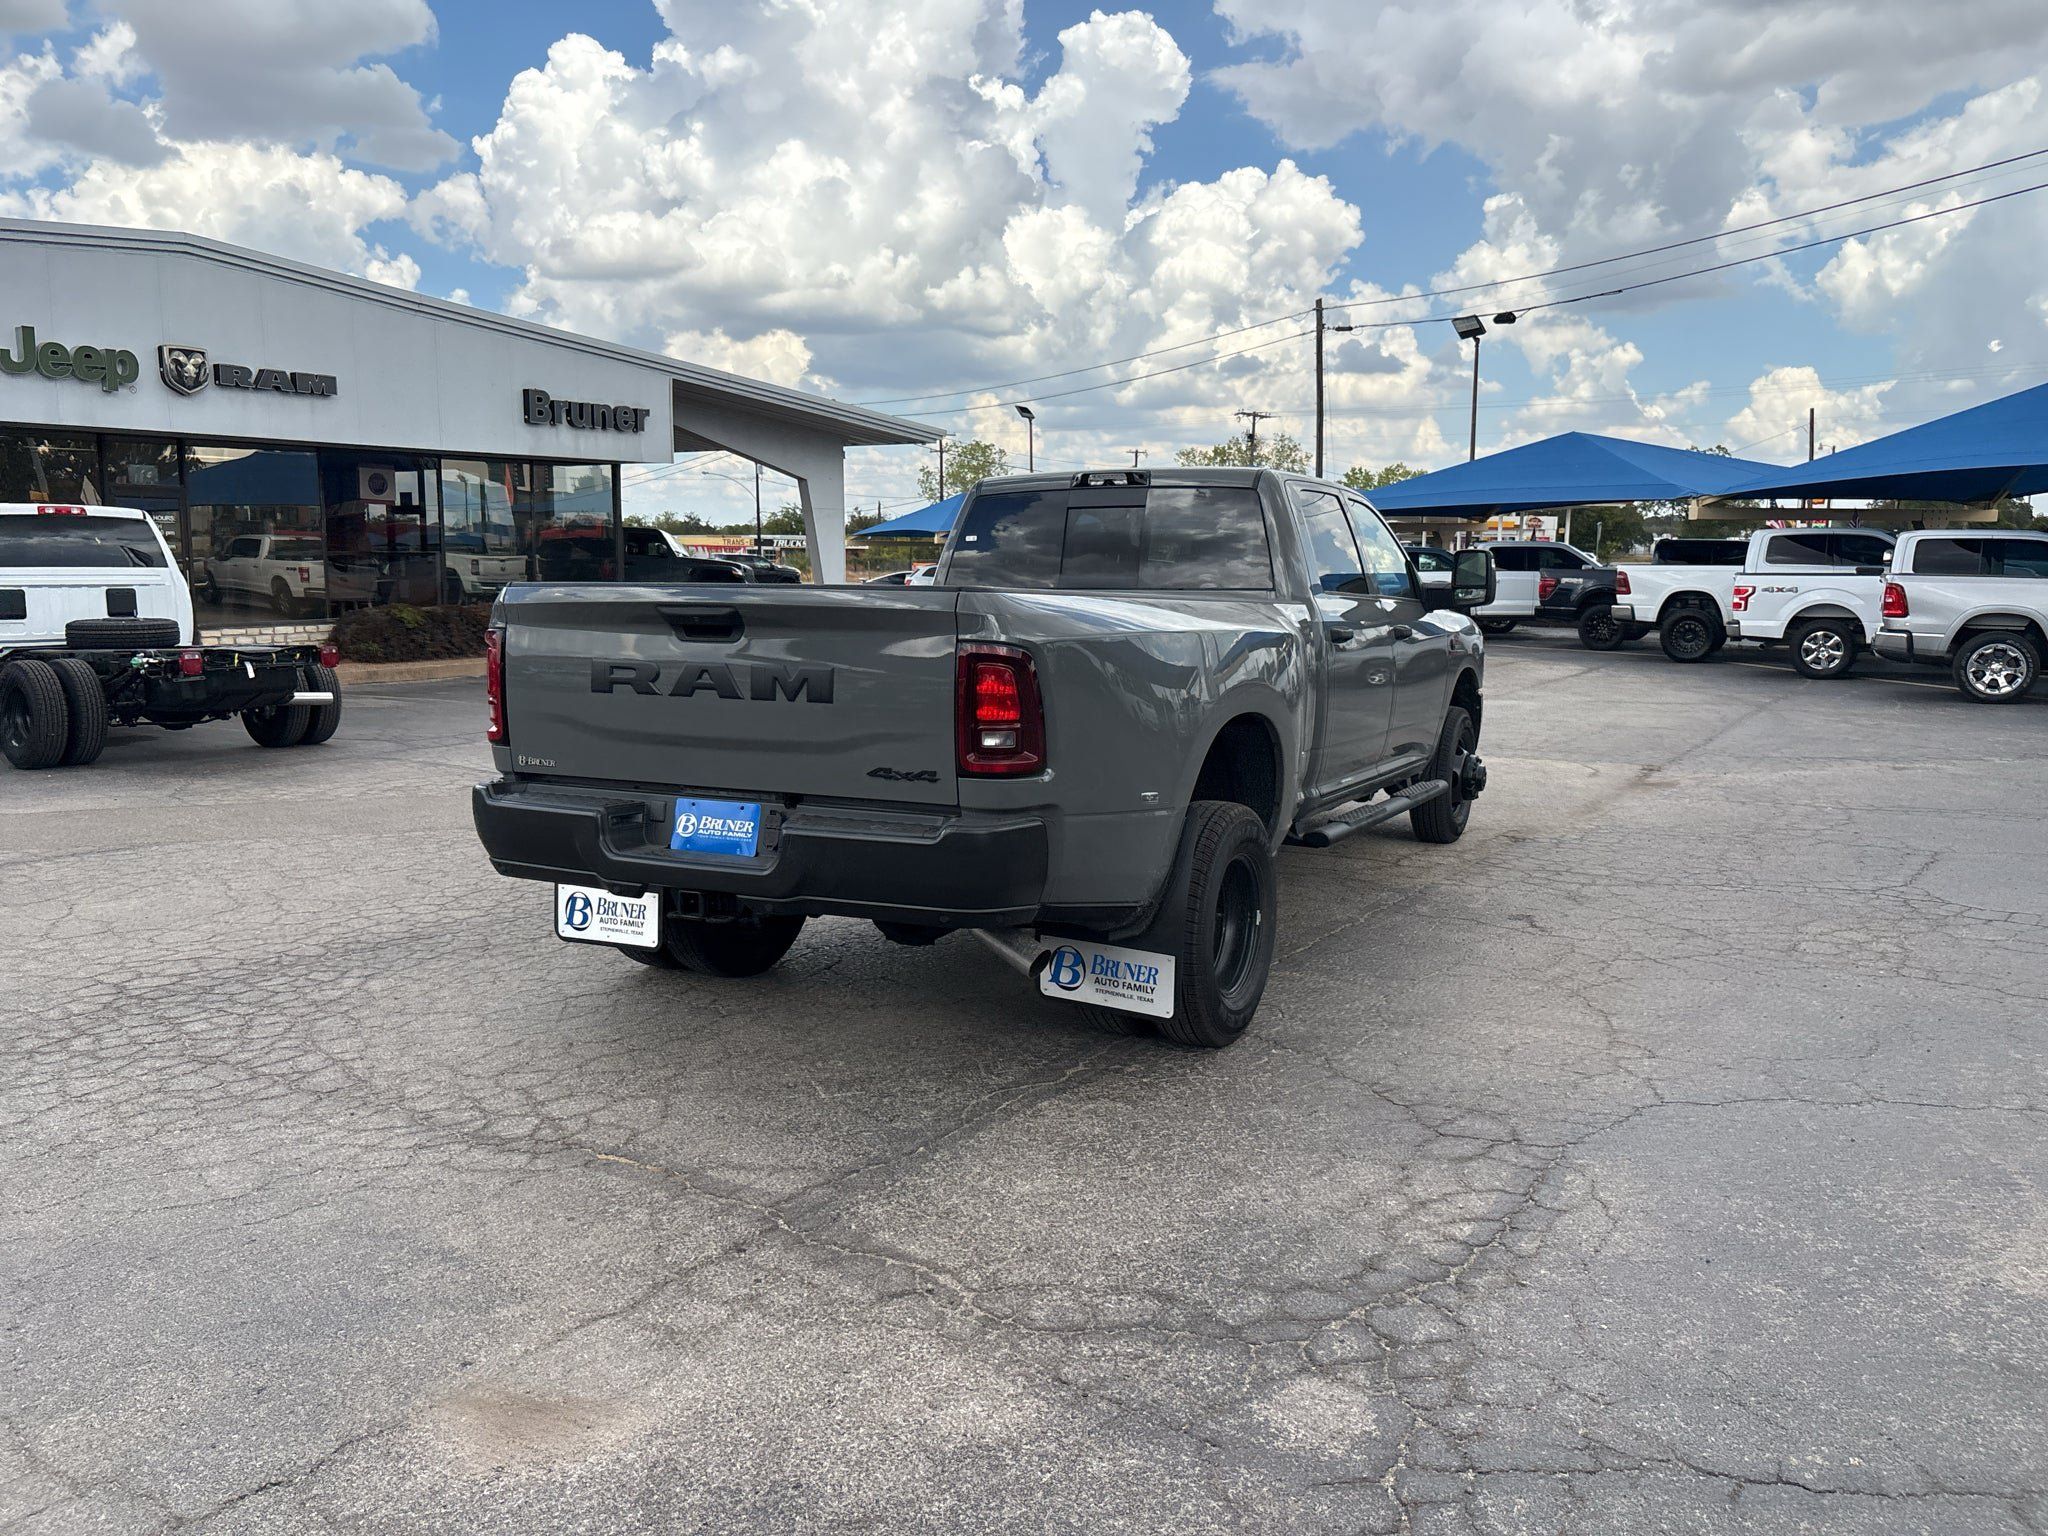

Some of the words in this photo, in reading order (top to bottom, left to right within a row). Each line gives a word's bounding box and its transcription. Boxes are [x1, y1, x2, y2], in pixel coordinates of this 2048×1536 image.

[0, 325, 140, 392] Jeep
[213, 363, 338, 396] RAM
[523, 388, 650, 432] Bruner
[591, 658, 835, 704] RAM
[698, 816, 755, 833] BRUNER
[596, 897, 647, 920] BRUNER
[599, 916, 618, 925] AUTO
[620, 918, 645, 928] FAMILY
[1090, 954, 1159, 985] BRUNER
[1094, 977, 1120, 988] AUTO
[1122, 982, 1156, 995] FAMILY
